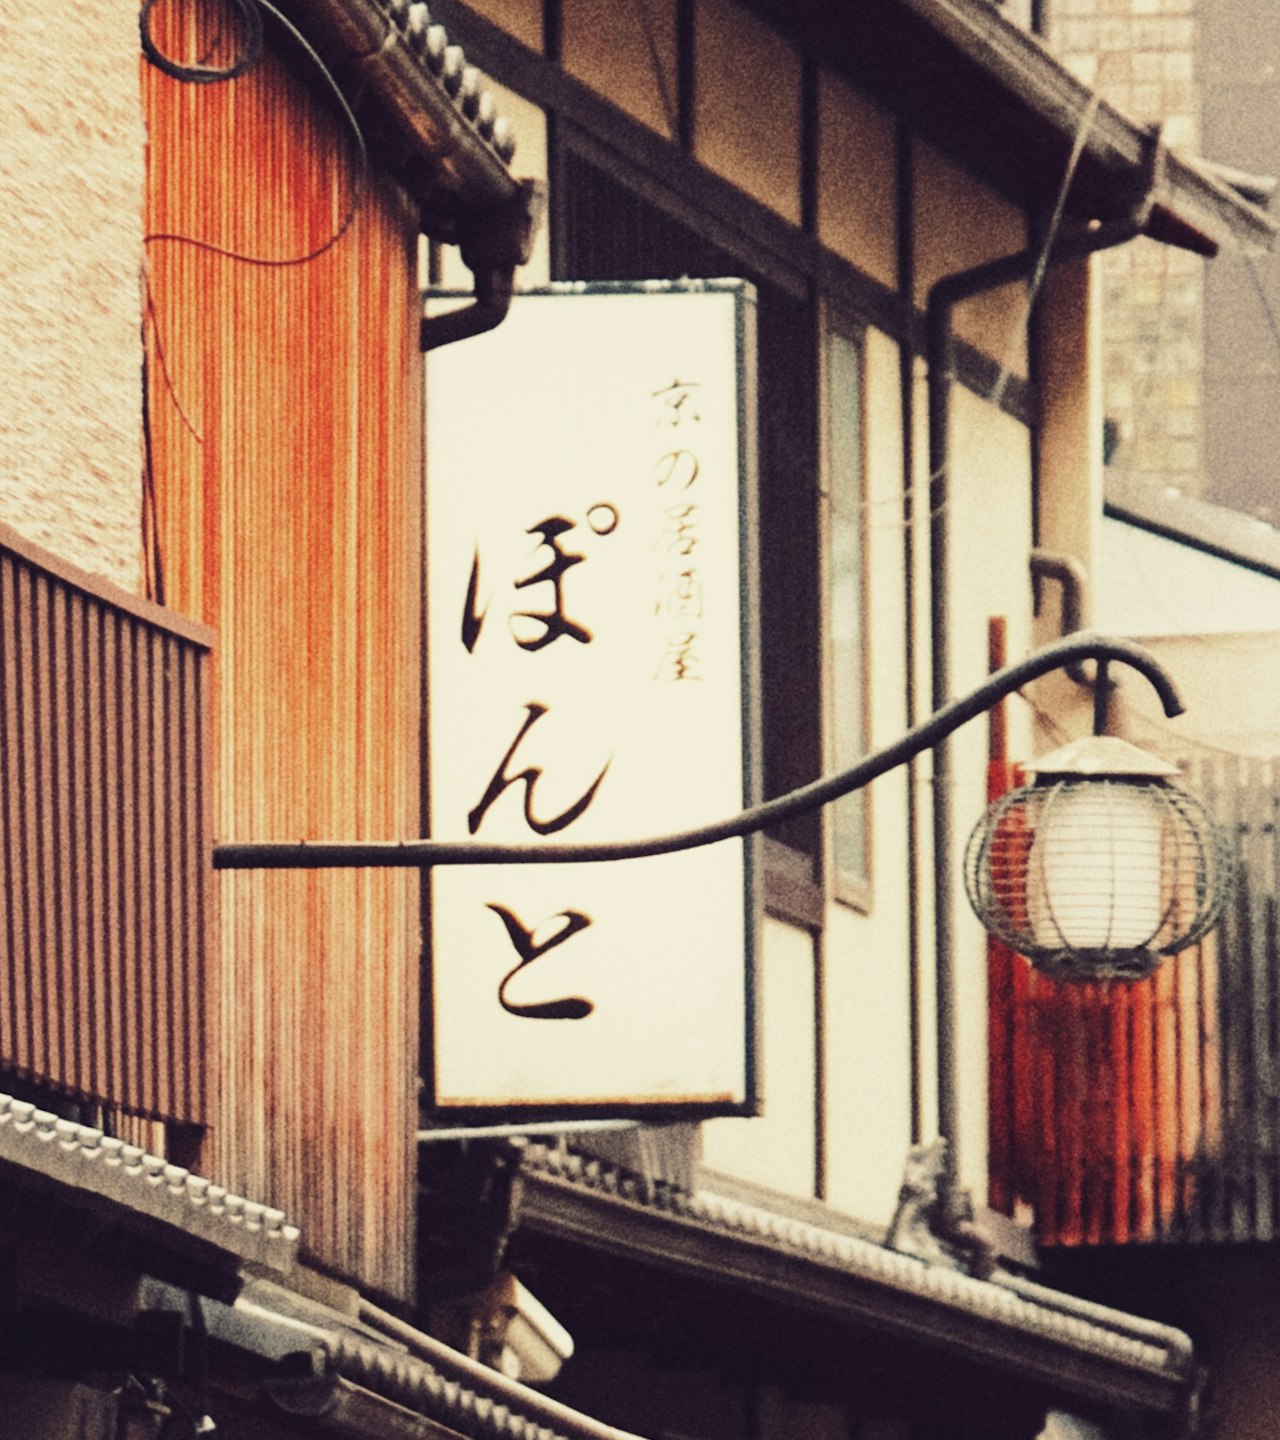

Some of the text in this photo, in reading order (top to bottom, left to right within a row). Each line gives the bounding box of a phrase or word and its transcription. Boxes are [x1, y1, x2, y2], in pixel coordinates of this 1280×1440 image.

[650, 378, 705, 684] 京の居酒屋
[459, 502, 620, 1021] ぽんと
